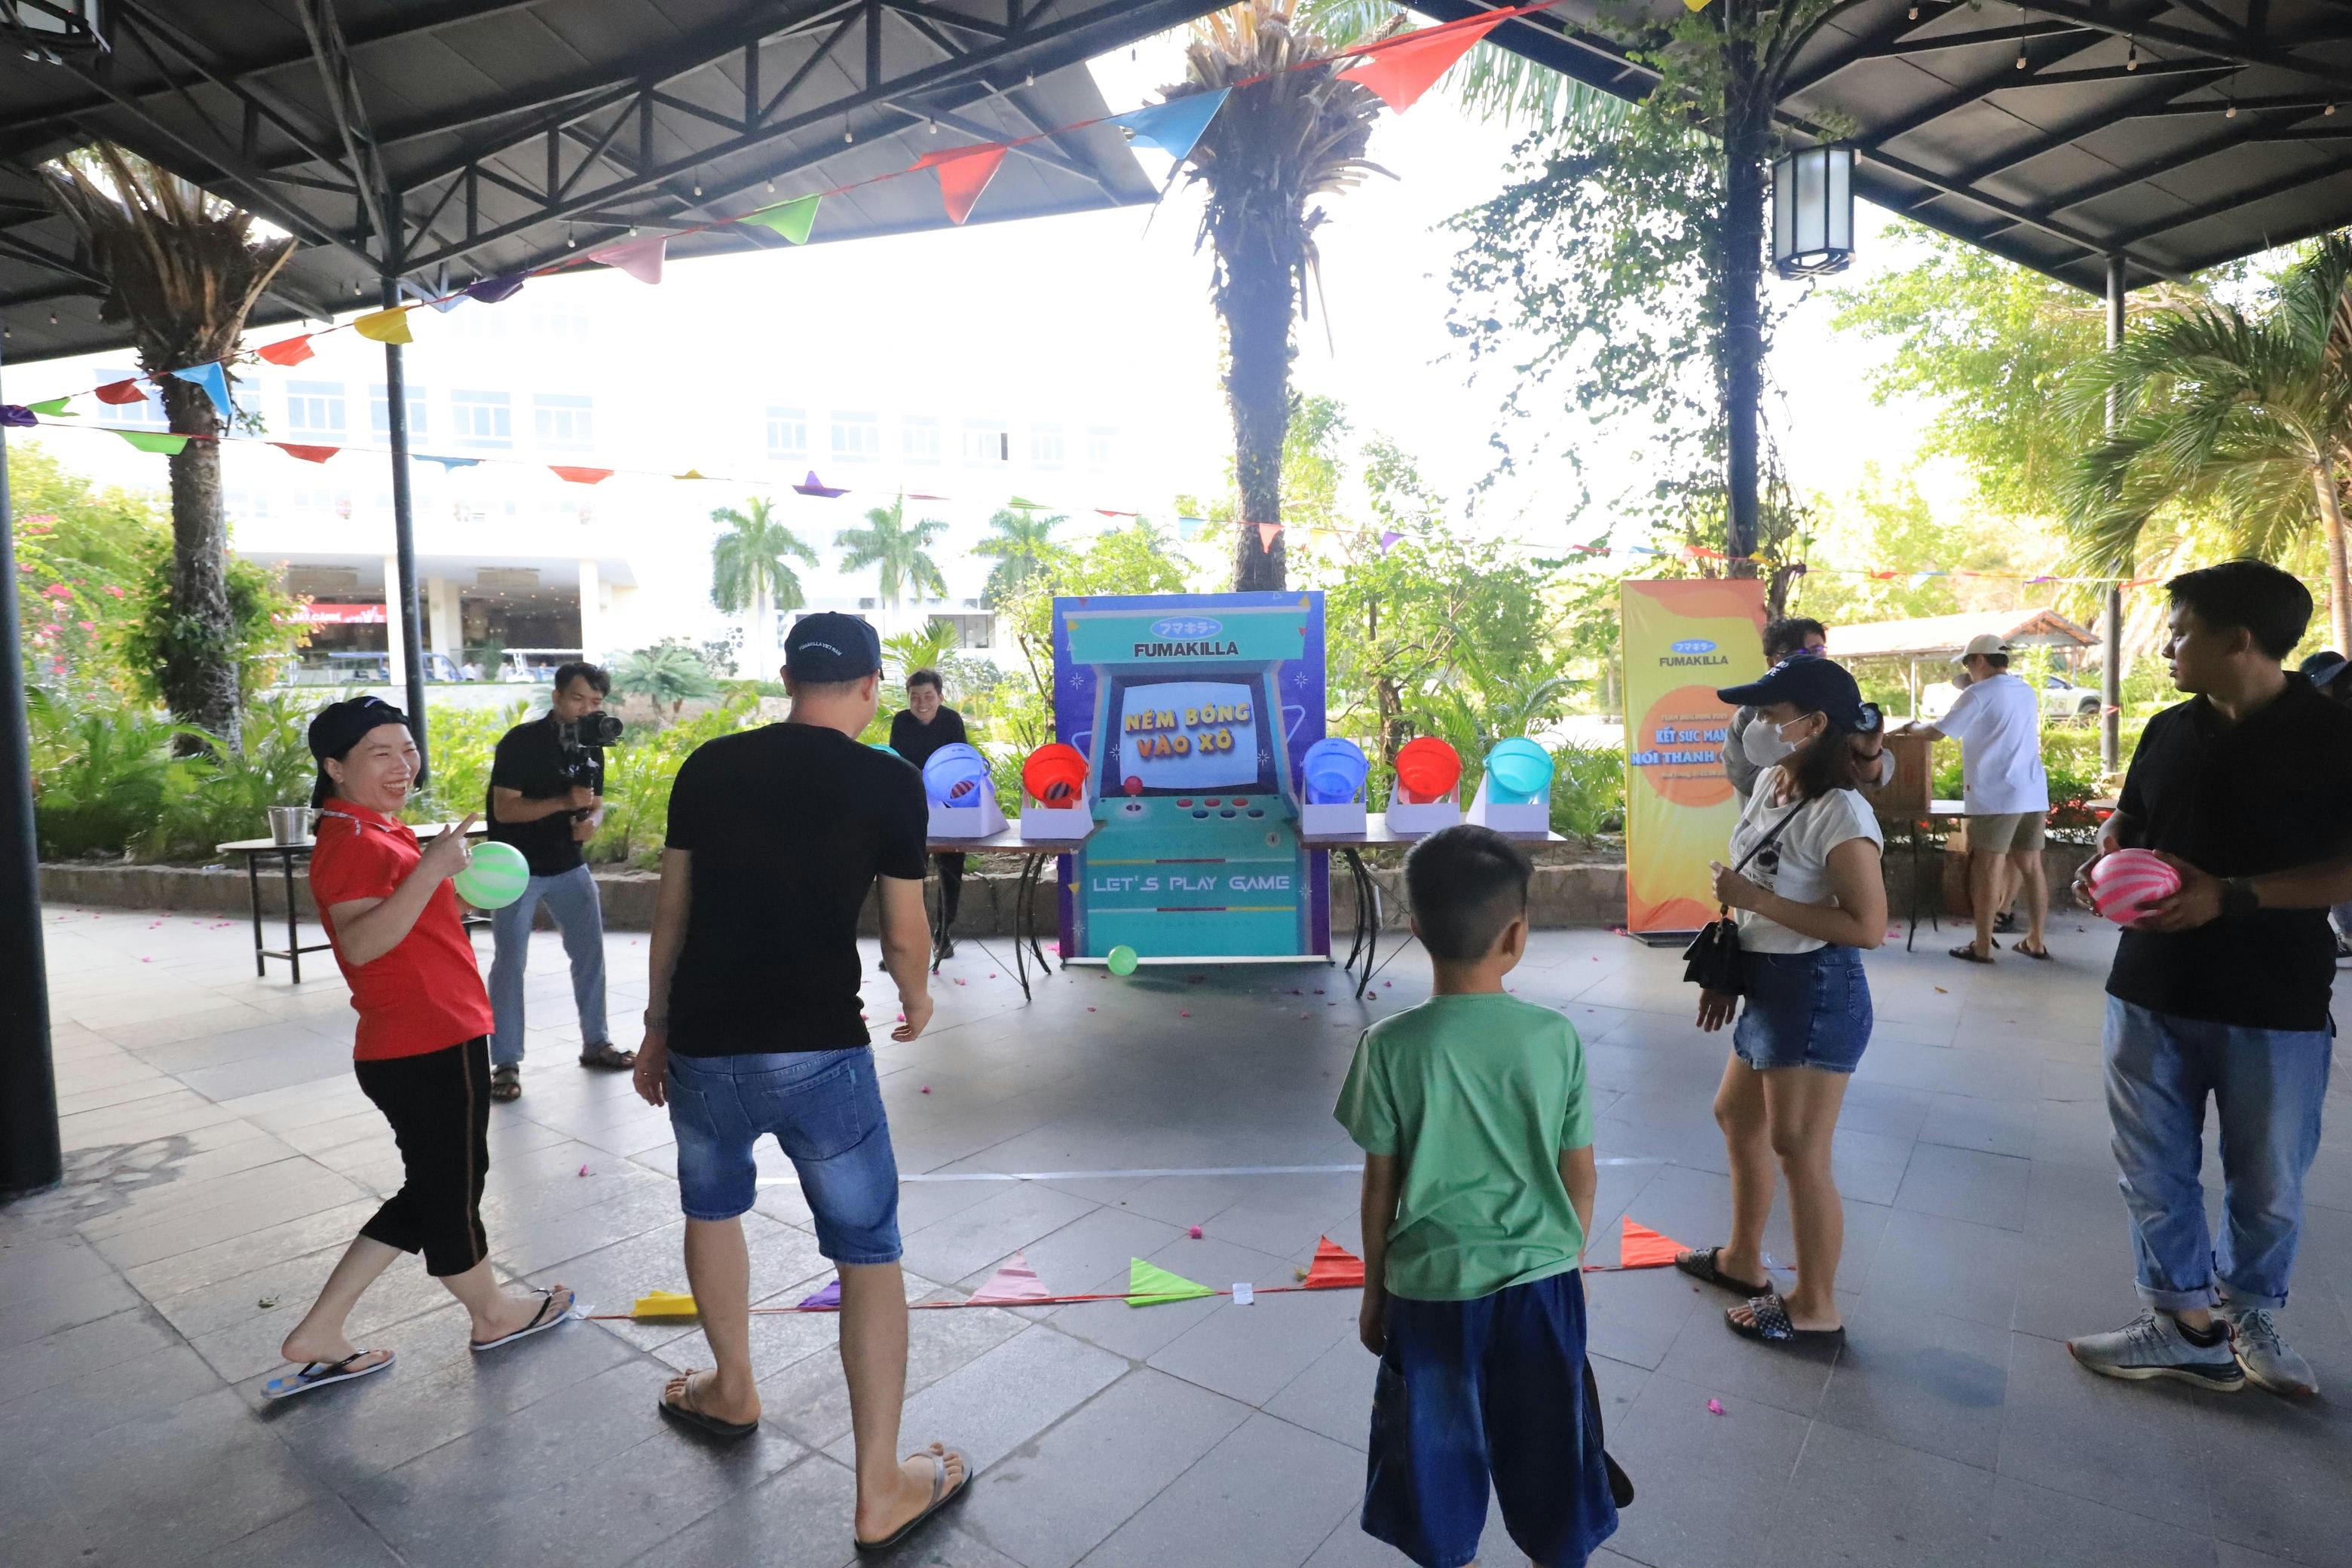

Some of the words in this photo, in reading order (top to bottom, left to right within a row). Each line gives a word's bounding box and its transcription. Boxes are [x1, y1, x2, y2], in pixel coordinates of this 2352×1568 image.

[1159, 621, 1216, 635] フマキラー
[1134, 642, 1239, 657] FUMAKILLA
[1659, 655, 1729, 666] FUMAKILLA
[1125, 709, 1177, 733] NÉM
[1185, 703, 1252, 727] BÓNG
[1137, 734, 1190, 758] VÀO
[1198, 727, 1234, 752] XÔ
[1655, 725, 1677, 744] KẾT
[1704, 728, 1729, 743] MẠN
[1662, 749, 1716, 764] THÀNH
[1093, 875, 1159, 893] LET'S
[1170, 876, 1217, 891] PLAY
[1229, 875, 1290, 892] GAME
